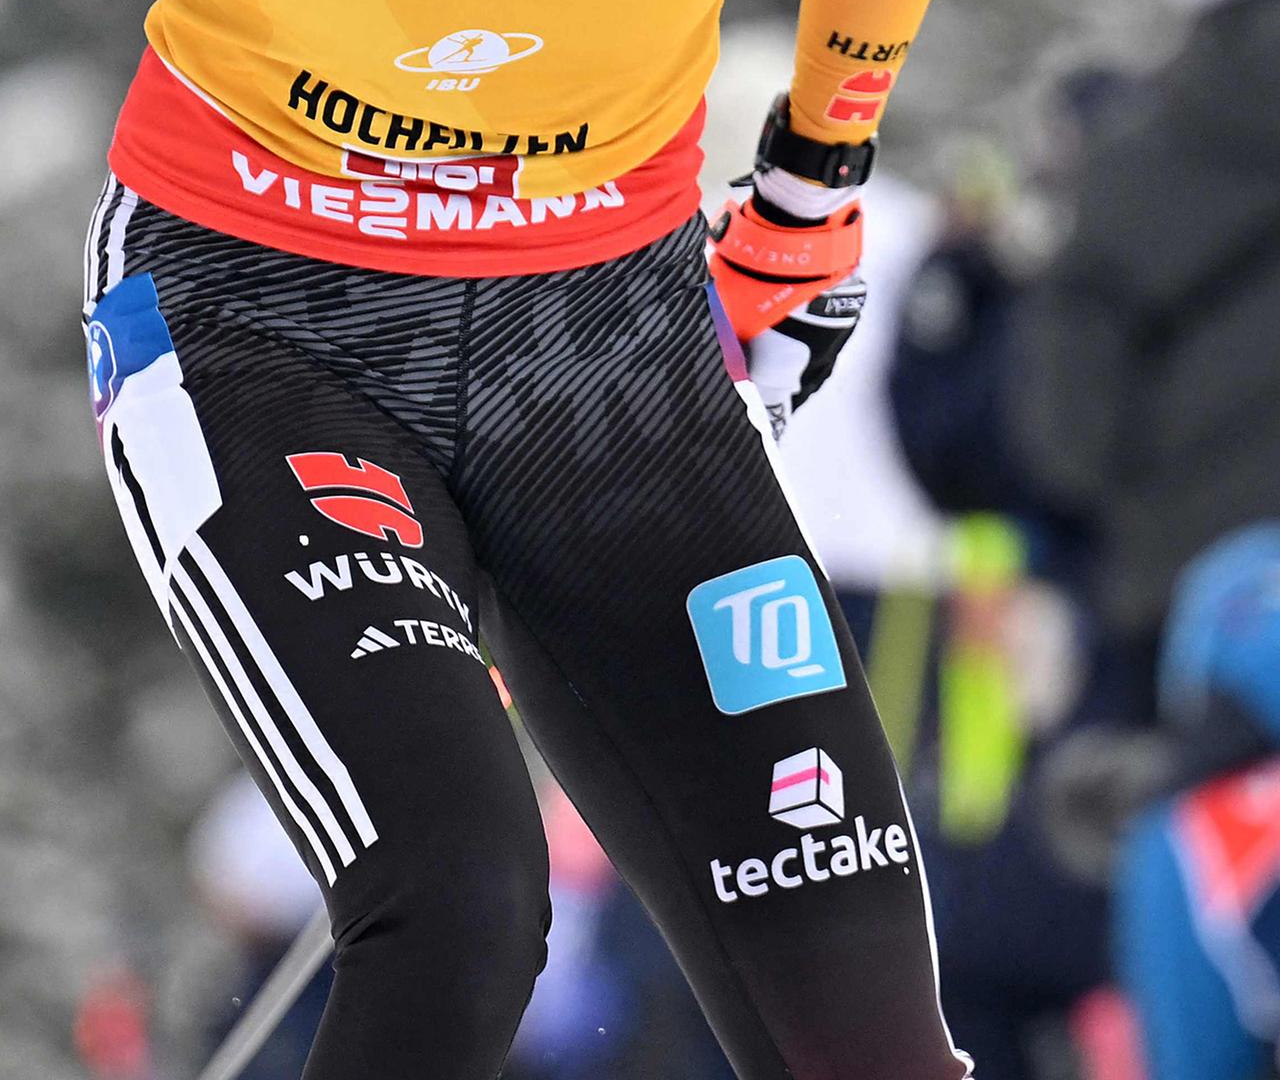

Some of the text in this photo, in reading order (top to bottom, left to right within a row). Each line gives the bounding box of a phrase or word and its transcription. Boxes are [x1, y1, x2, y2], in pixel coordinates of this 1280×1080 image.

[426, 77, 481, 91] IBU
[393, 619, 486, 666] TERR
[713, 579, 826, 678] TQ
[710, 814, 910, 903] tectake
